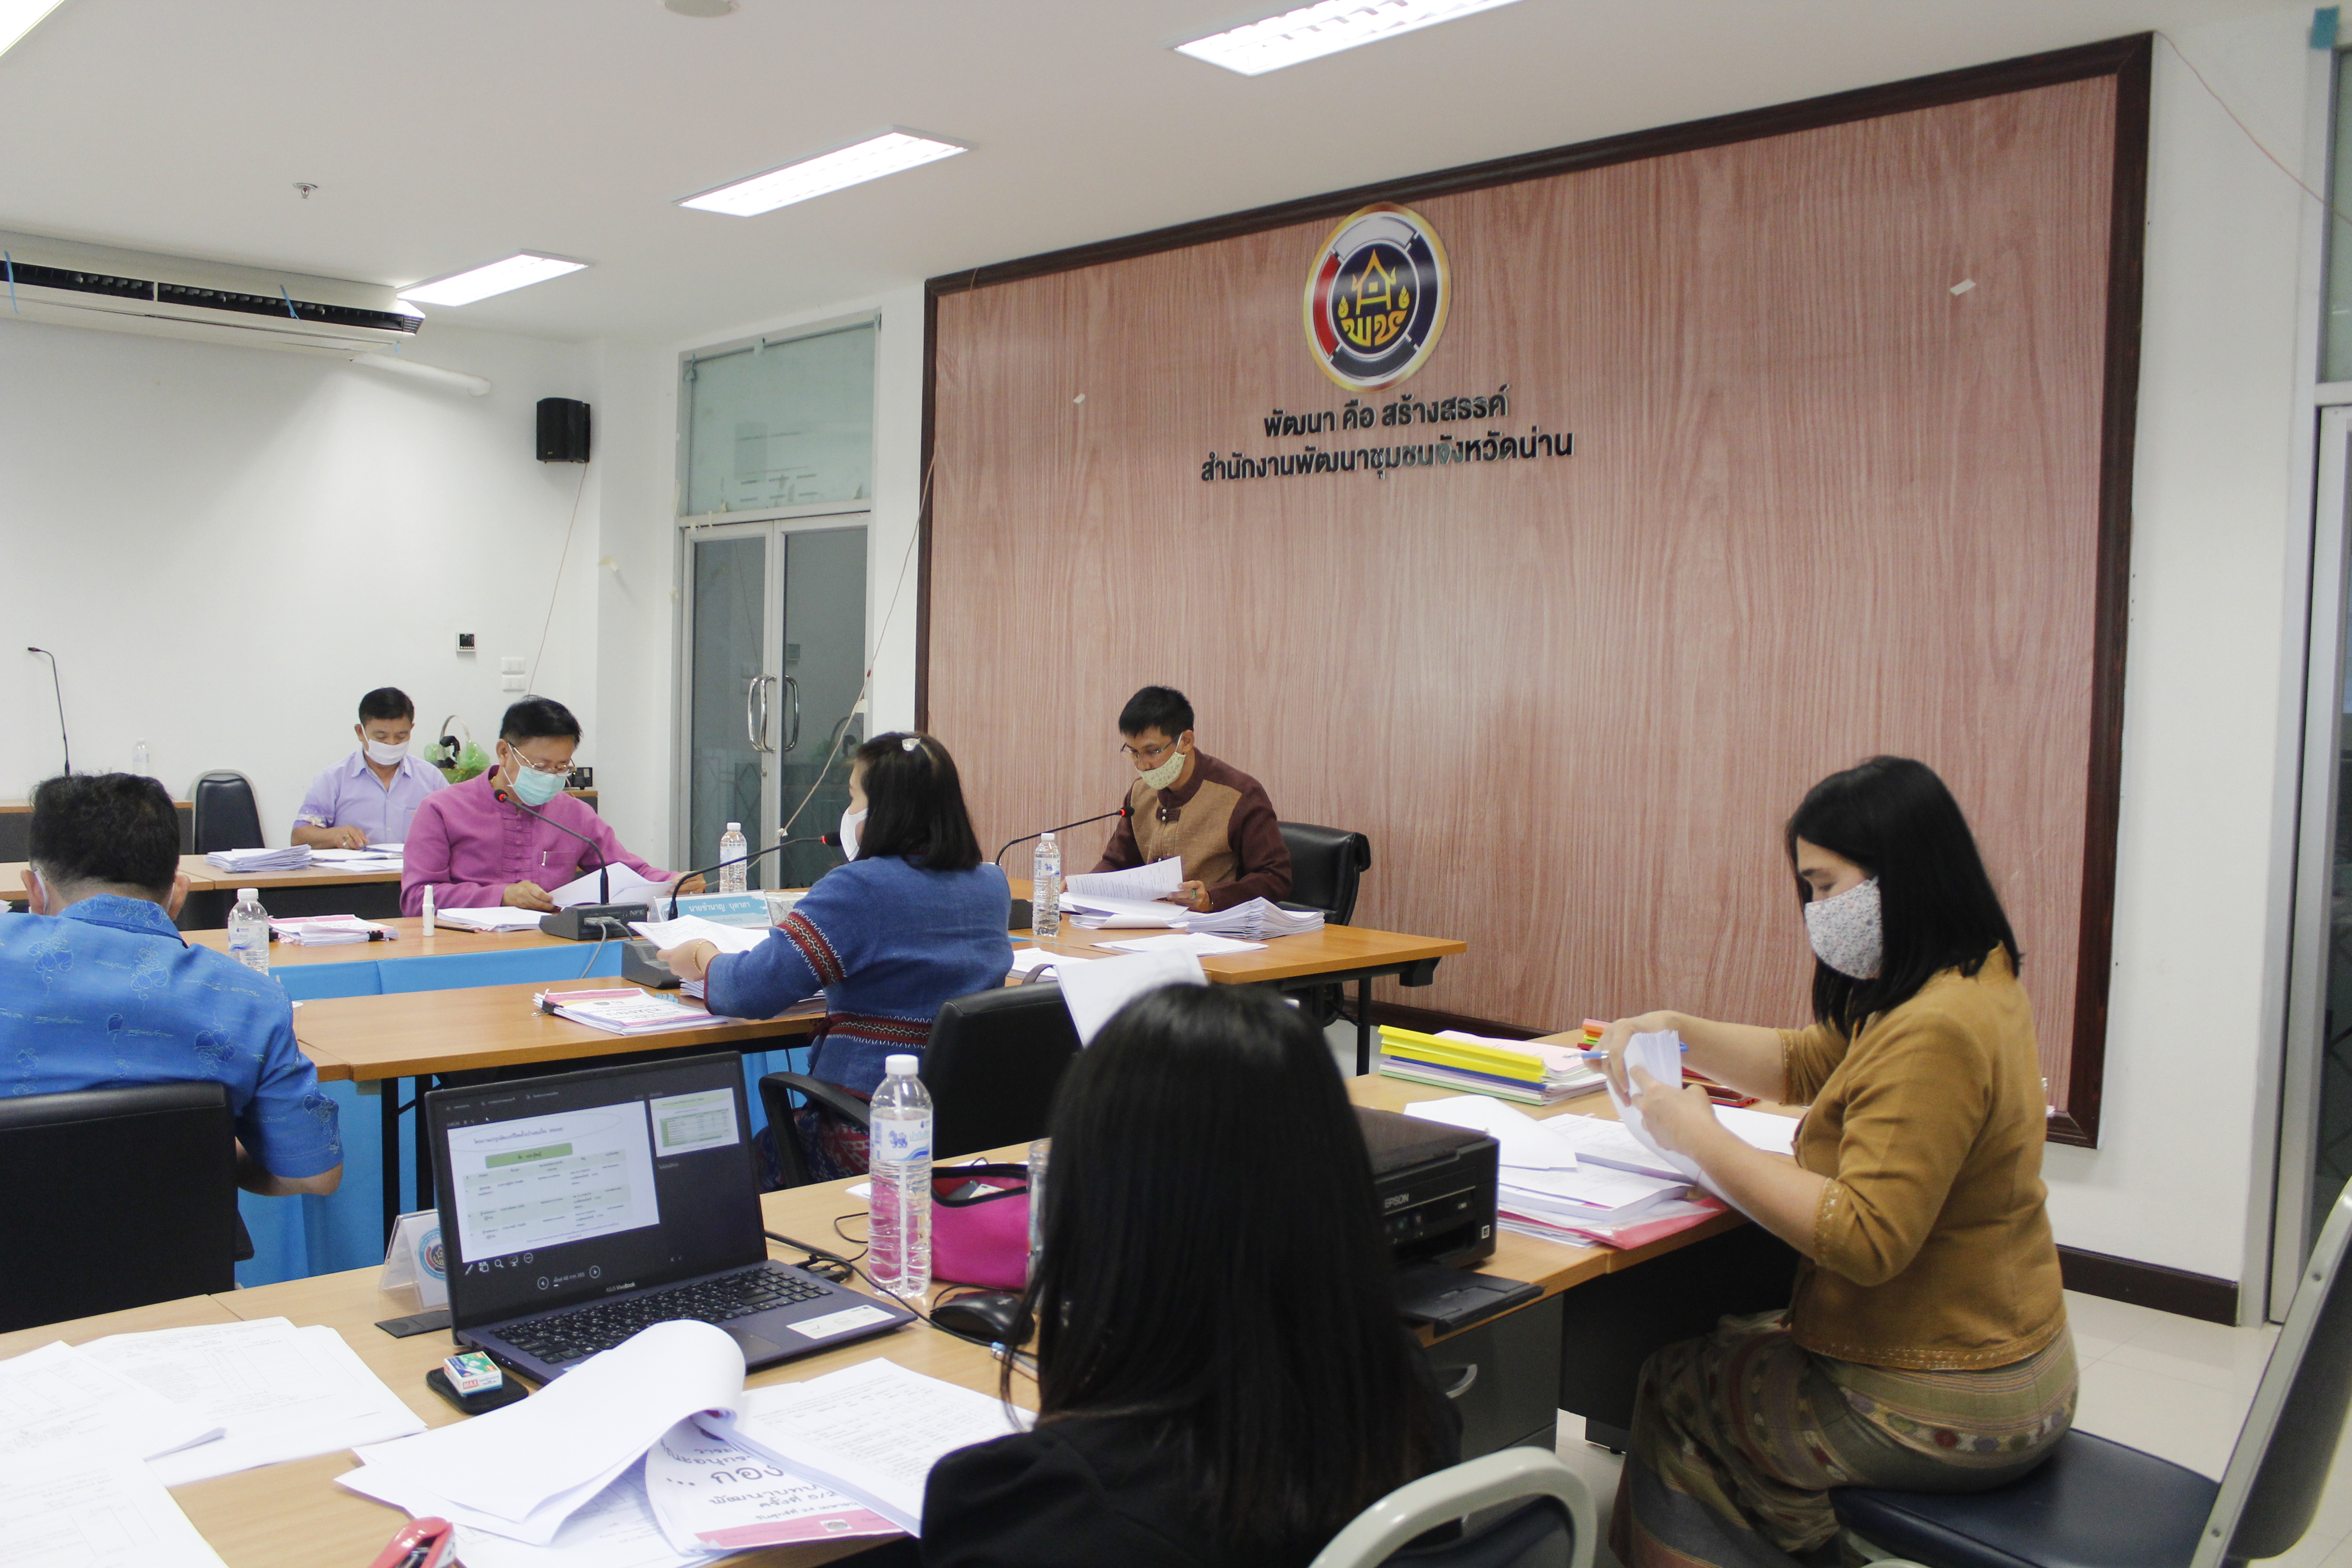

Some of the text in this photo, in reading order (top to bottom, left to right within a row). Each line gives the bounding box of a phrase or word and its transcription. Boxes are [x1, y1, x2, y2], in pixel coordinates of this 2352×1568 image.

[1264, 384, 1509, 437] พัฒนา คือ สร้างสรรค์
[1201, 426, 1573, 481] สำนักงานพัฒนาชุมชนจังหวัดน่าน
[1385, 1193, 1409, 1209] EPSON
[616, 1281, 635, 1290] VivoBook
[463, 1379, 478, 1388] MAX
[710, 1465, 784, 1484] กอง
[709, 1484, 818, 1504] พัฒนาบทบ
